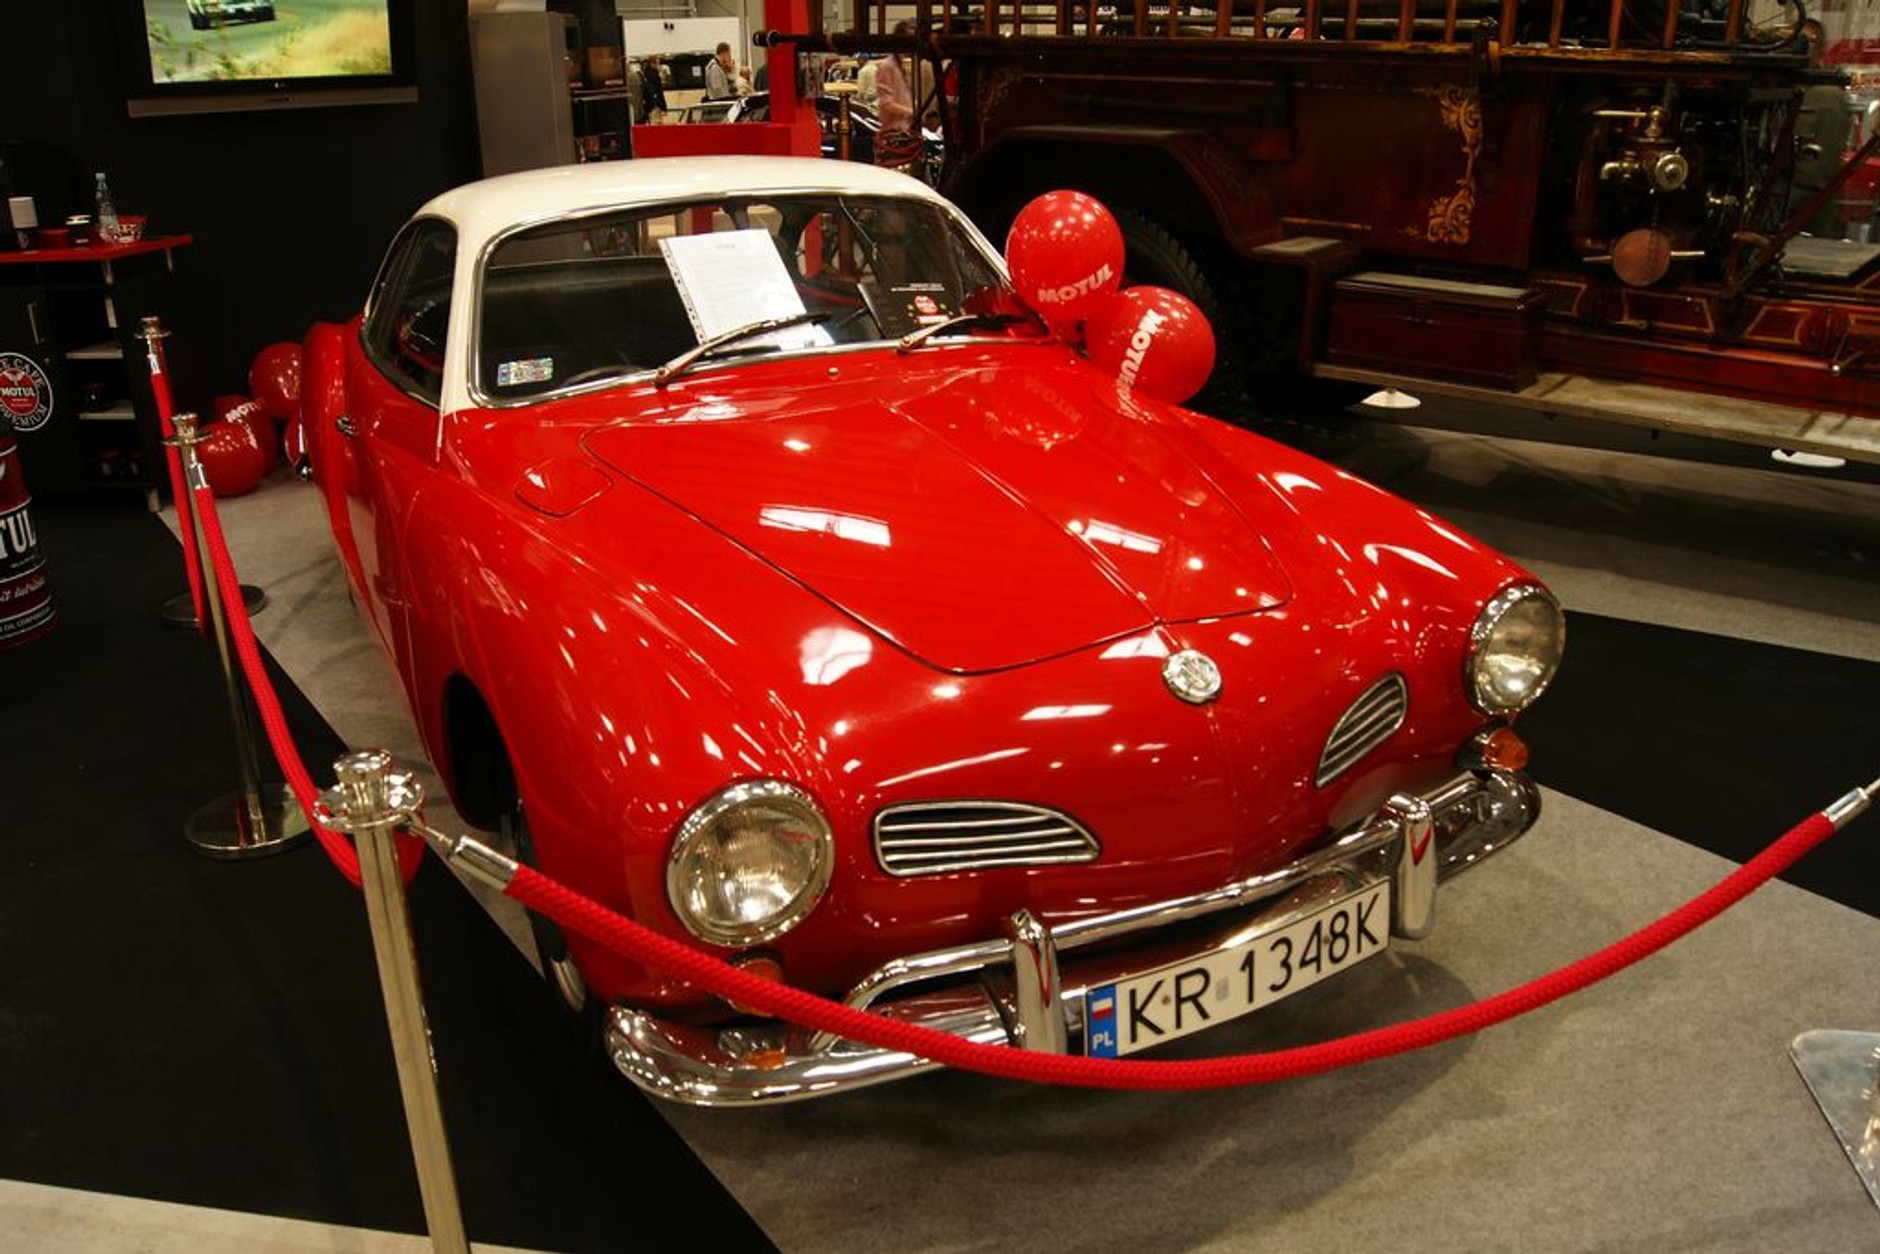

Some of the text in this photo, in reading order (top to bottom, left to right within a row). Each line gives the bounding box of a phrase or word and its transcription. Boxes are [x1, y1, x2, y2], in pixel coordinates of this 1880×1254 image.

[1037, 264, 1114, 303] MOTUL
[2, 387, 36, 397] MOTUL
[225, 401, 262, 423] MOTU
[1129, 893, 1382, 1044] KR 1348K
[1092, 1032, 1114, 1050] PL
